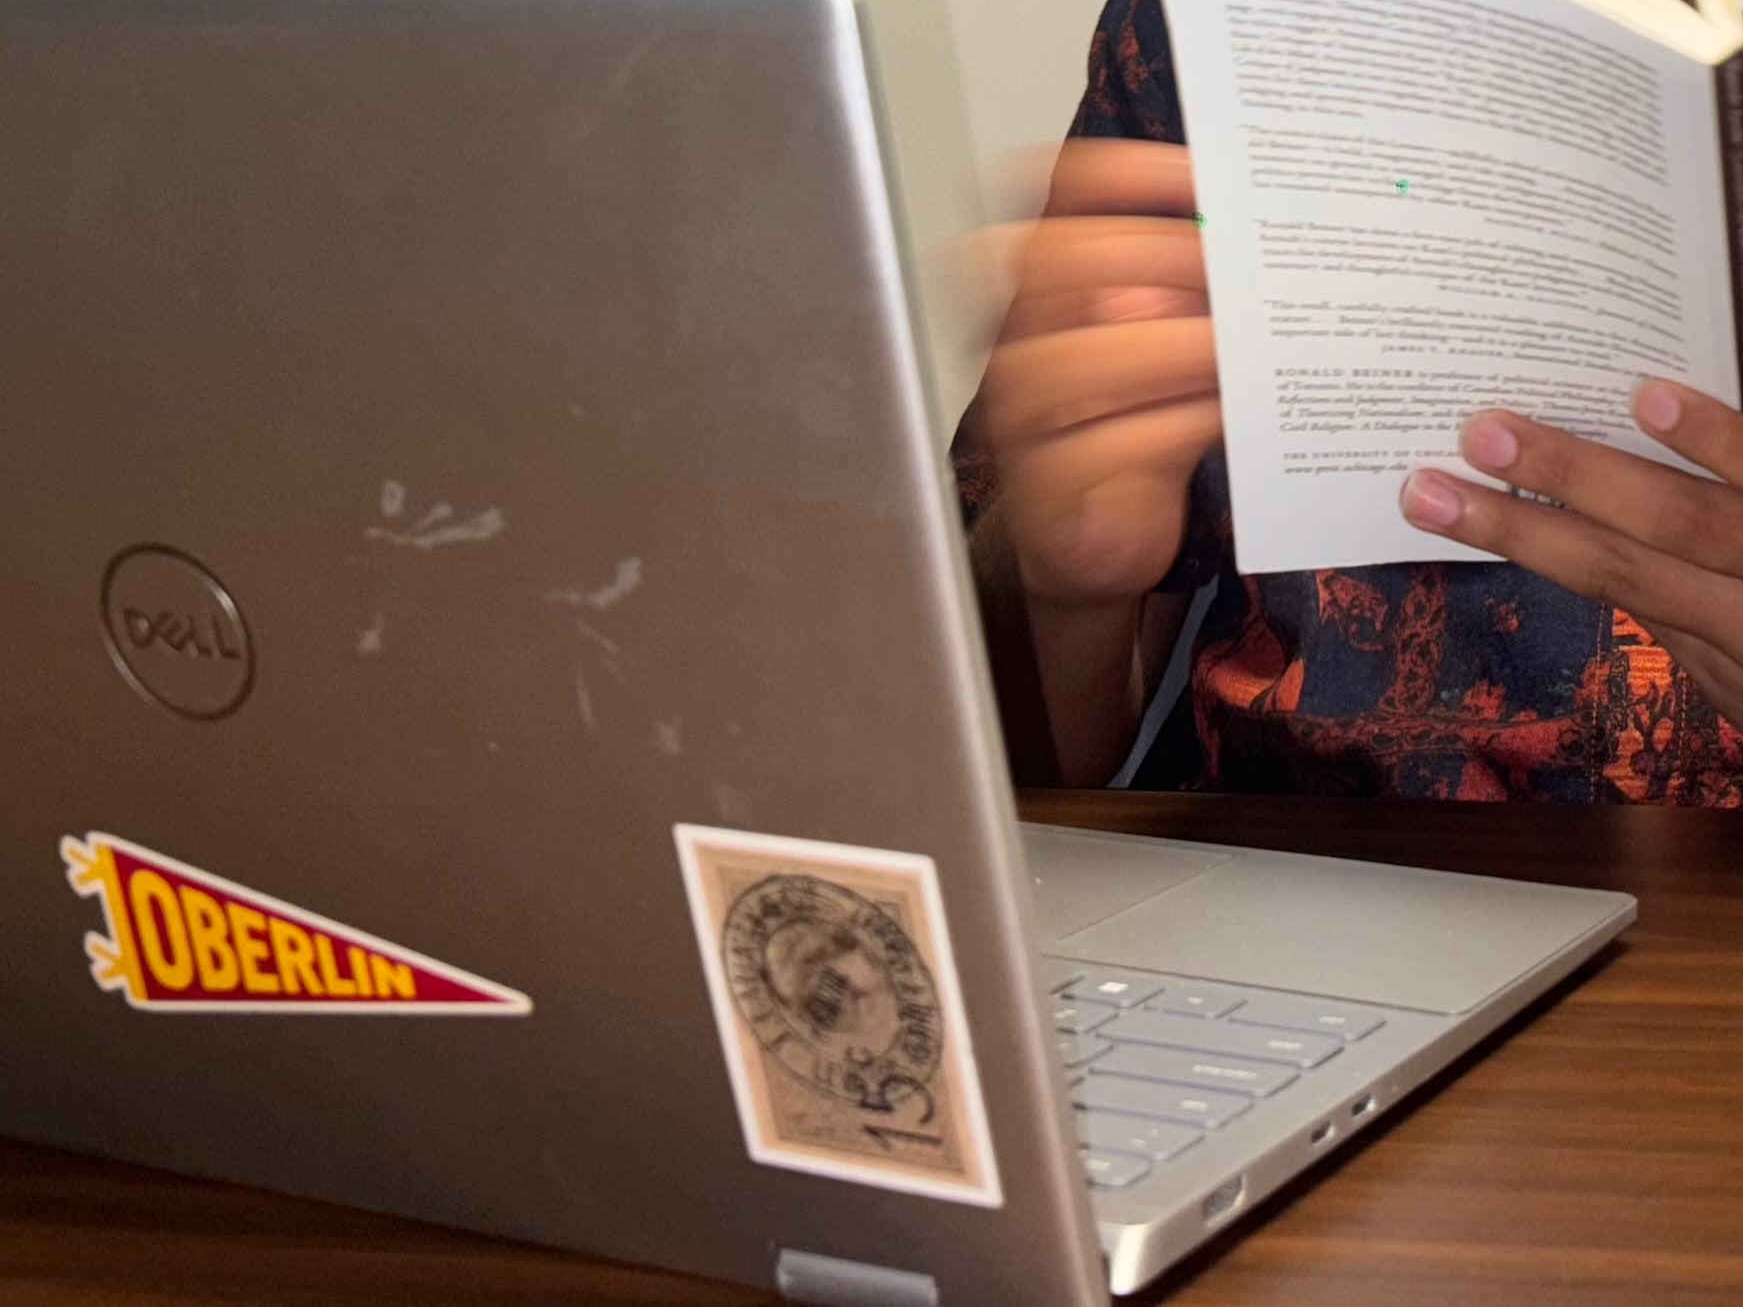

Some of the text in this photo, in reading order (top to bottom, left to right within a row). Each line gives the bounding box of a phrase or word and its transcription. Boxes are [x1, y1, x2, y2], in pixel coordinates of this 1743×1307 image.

[1275, 368, 1346, 379] RONALD
[1352, 369, 1414, 379] BEINER
[121, 605, 241, 661] DELL
[128, 869, 418, 1001] OBERLIN
